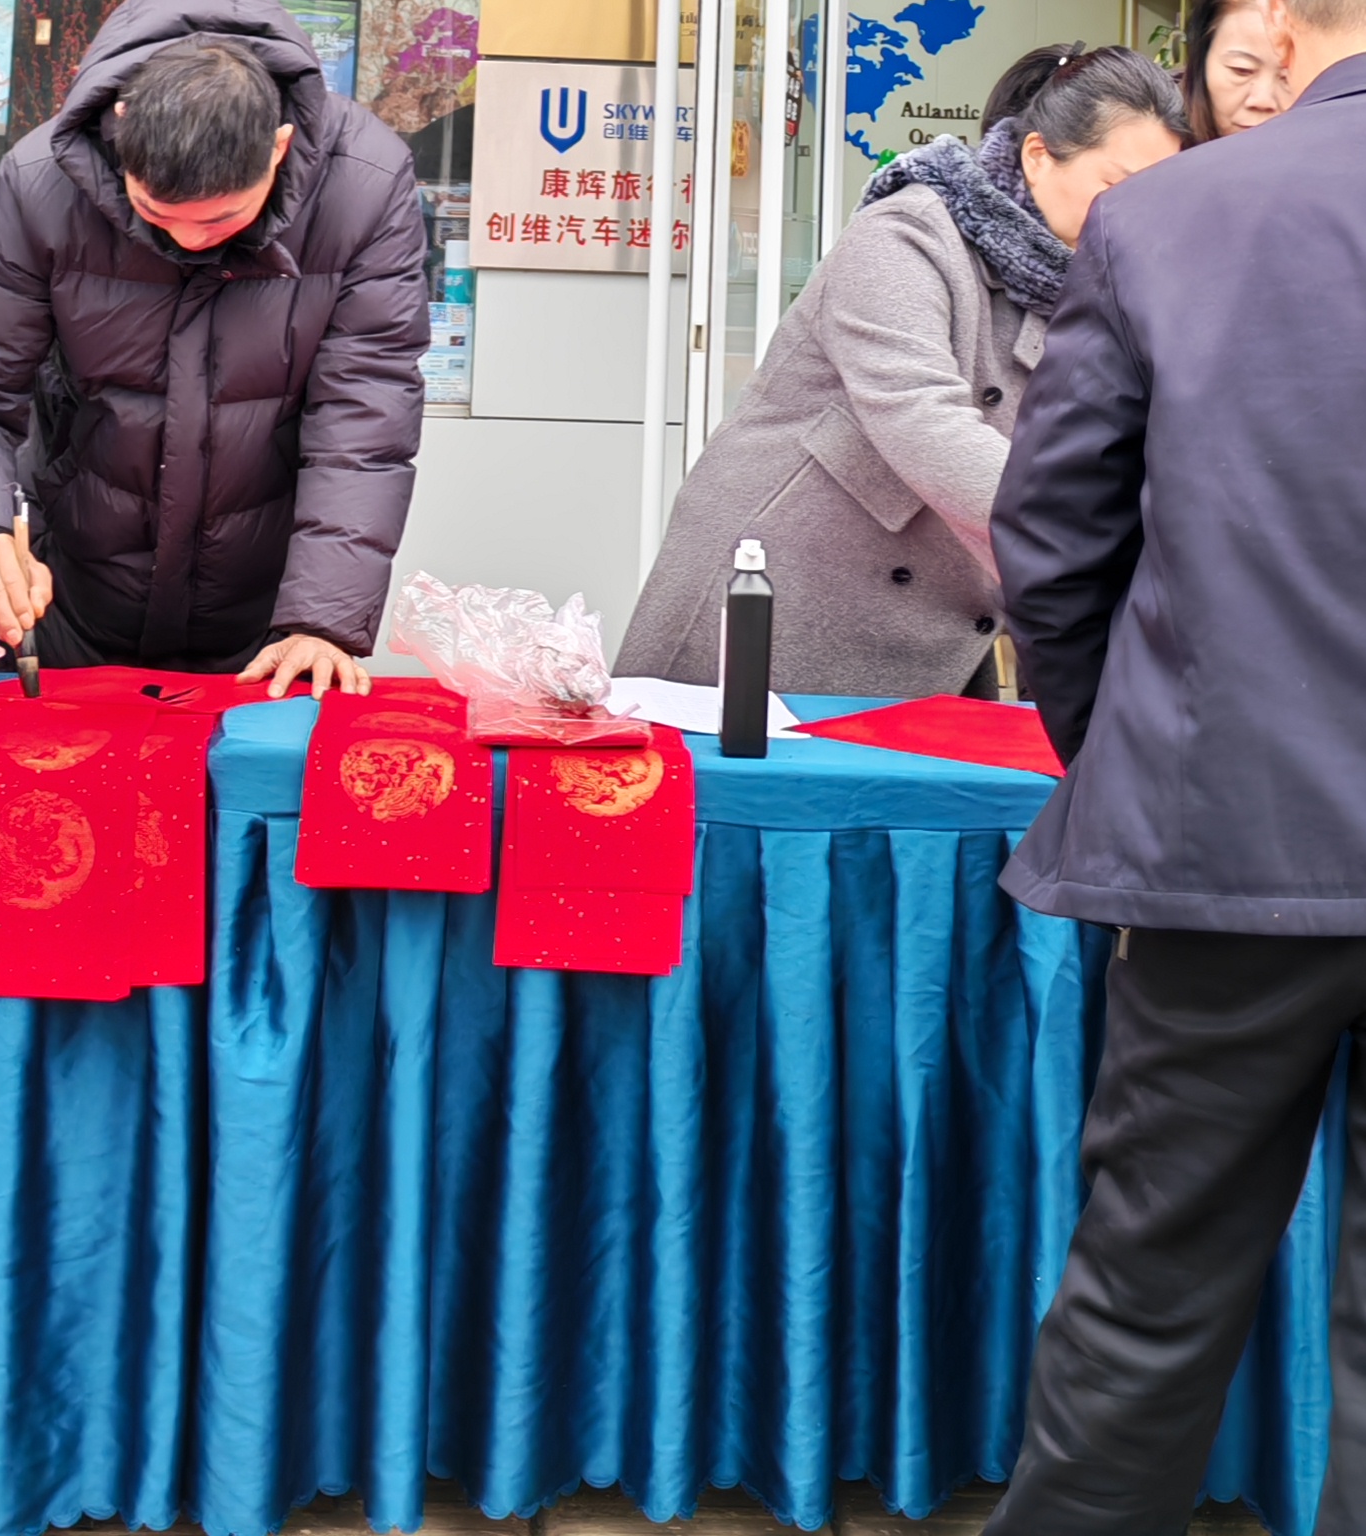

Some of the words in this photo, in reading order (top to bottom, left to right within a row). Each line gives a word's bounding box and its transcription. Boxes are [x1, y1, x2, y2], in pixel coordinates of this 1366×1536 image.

[603, 103, 693, 122] SKYWR
[900, 100, 981, 120] Atlantic
[602, 122, 693, 142] 创维车
[909, 128, 968, 146] Ocn
